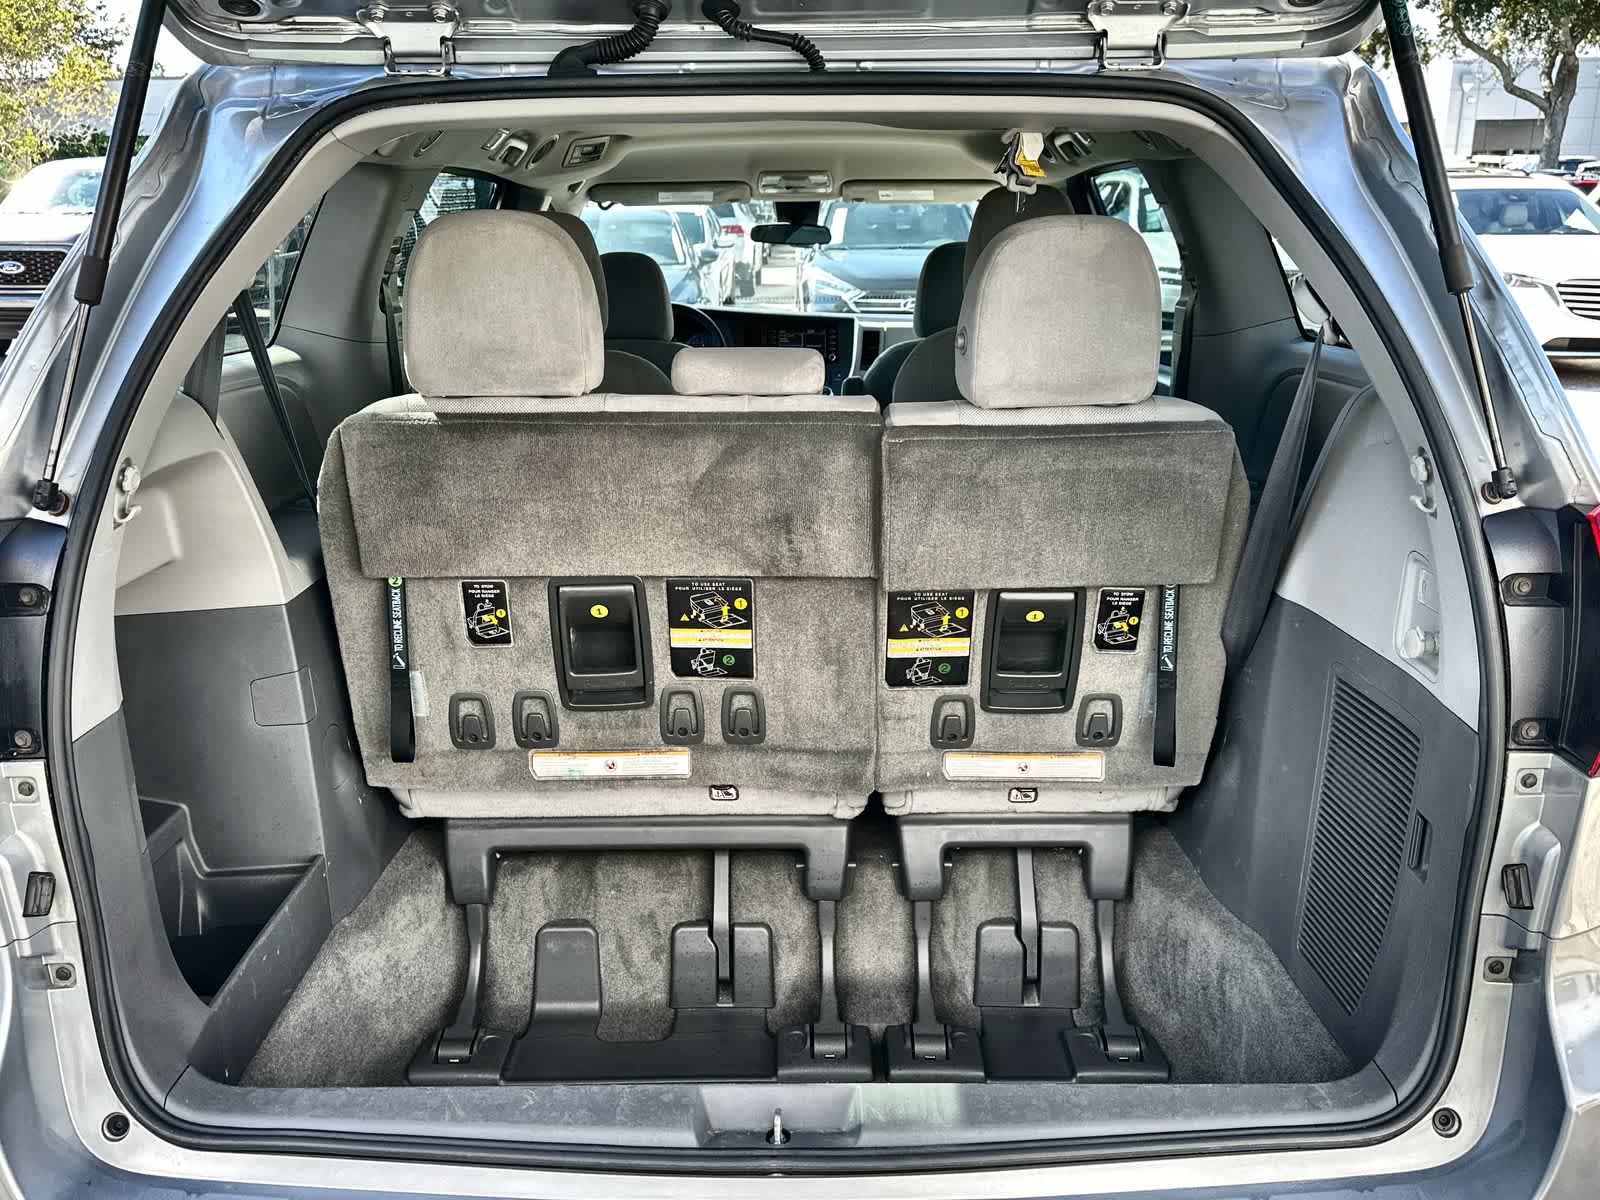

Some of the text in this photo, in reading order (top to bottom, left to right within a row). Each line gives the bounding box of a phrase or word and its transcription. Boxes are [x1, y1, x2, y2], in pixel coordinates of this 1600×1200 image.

[391, 588, 404, 652] TO RECLINE SEATBACK
[1163, 620, 1174, 646] RECLINE
[1163, 645, 1173, 653] TO
